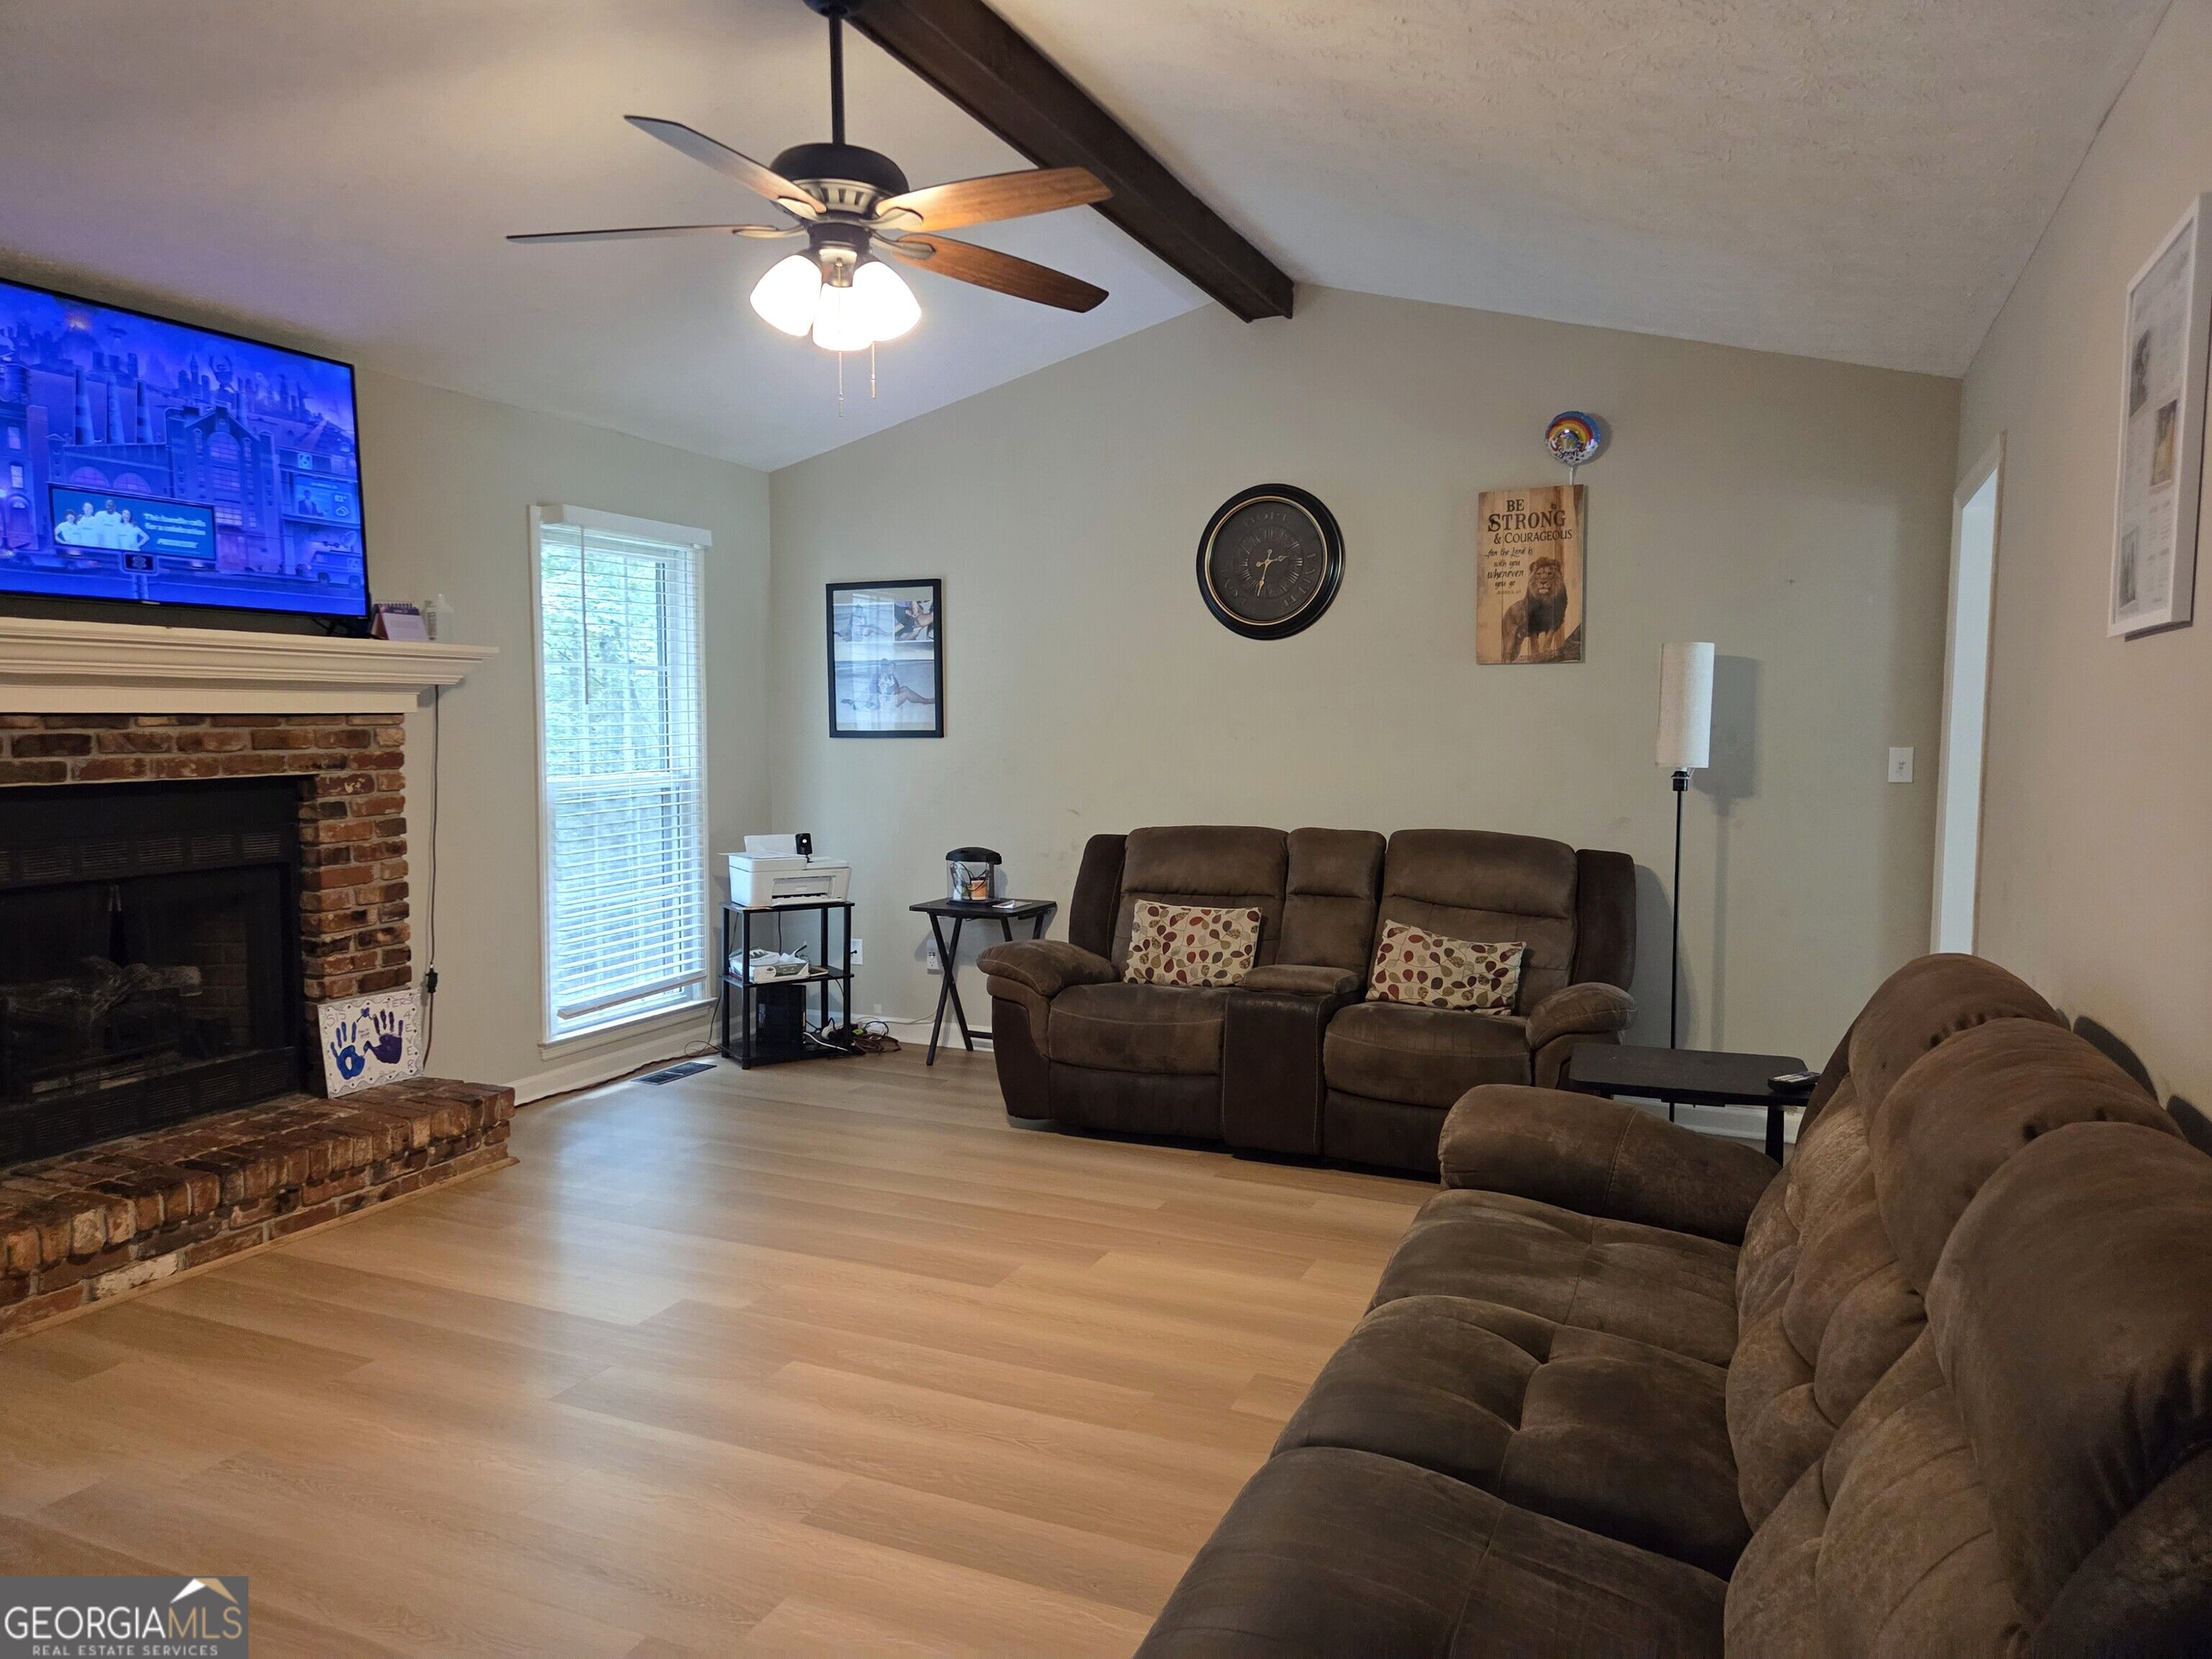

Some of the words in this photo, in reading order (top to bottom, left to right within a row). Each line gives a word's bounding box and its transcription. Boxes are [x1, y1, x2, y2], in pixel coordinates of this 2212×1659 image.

[1506, 499, 1524, 512] BE
[1488, 510, 1566, 532] STRONG
[1493, 533, 1501, 544] &
[1504, 529, 1573, 544] COURAGEOUS
[1484, 549, 1498, 559] for
[1501, 547, 1509, 556] the
[1510, 547, 1526, 558] Lord
[1509, 560, 1521, 569] you
[1495, 581, 1506, 590] you
